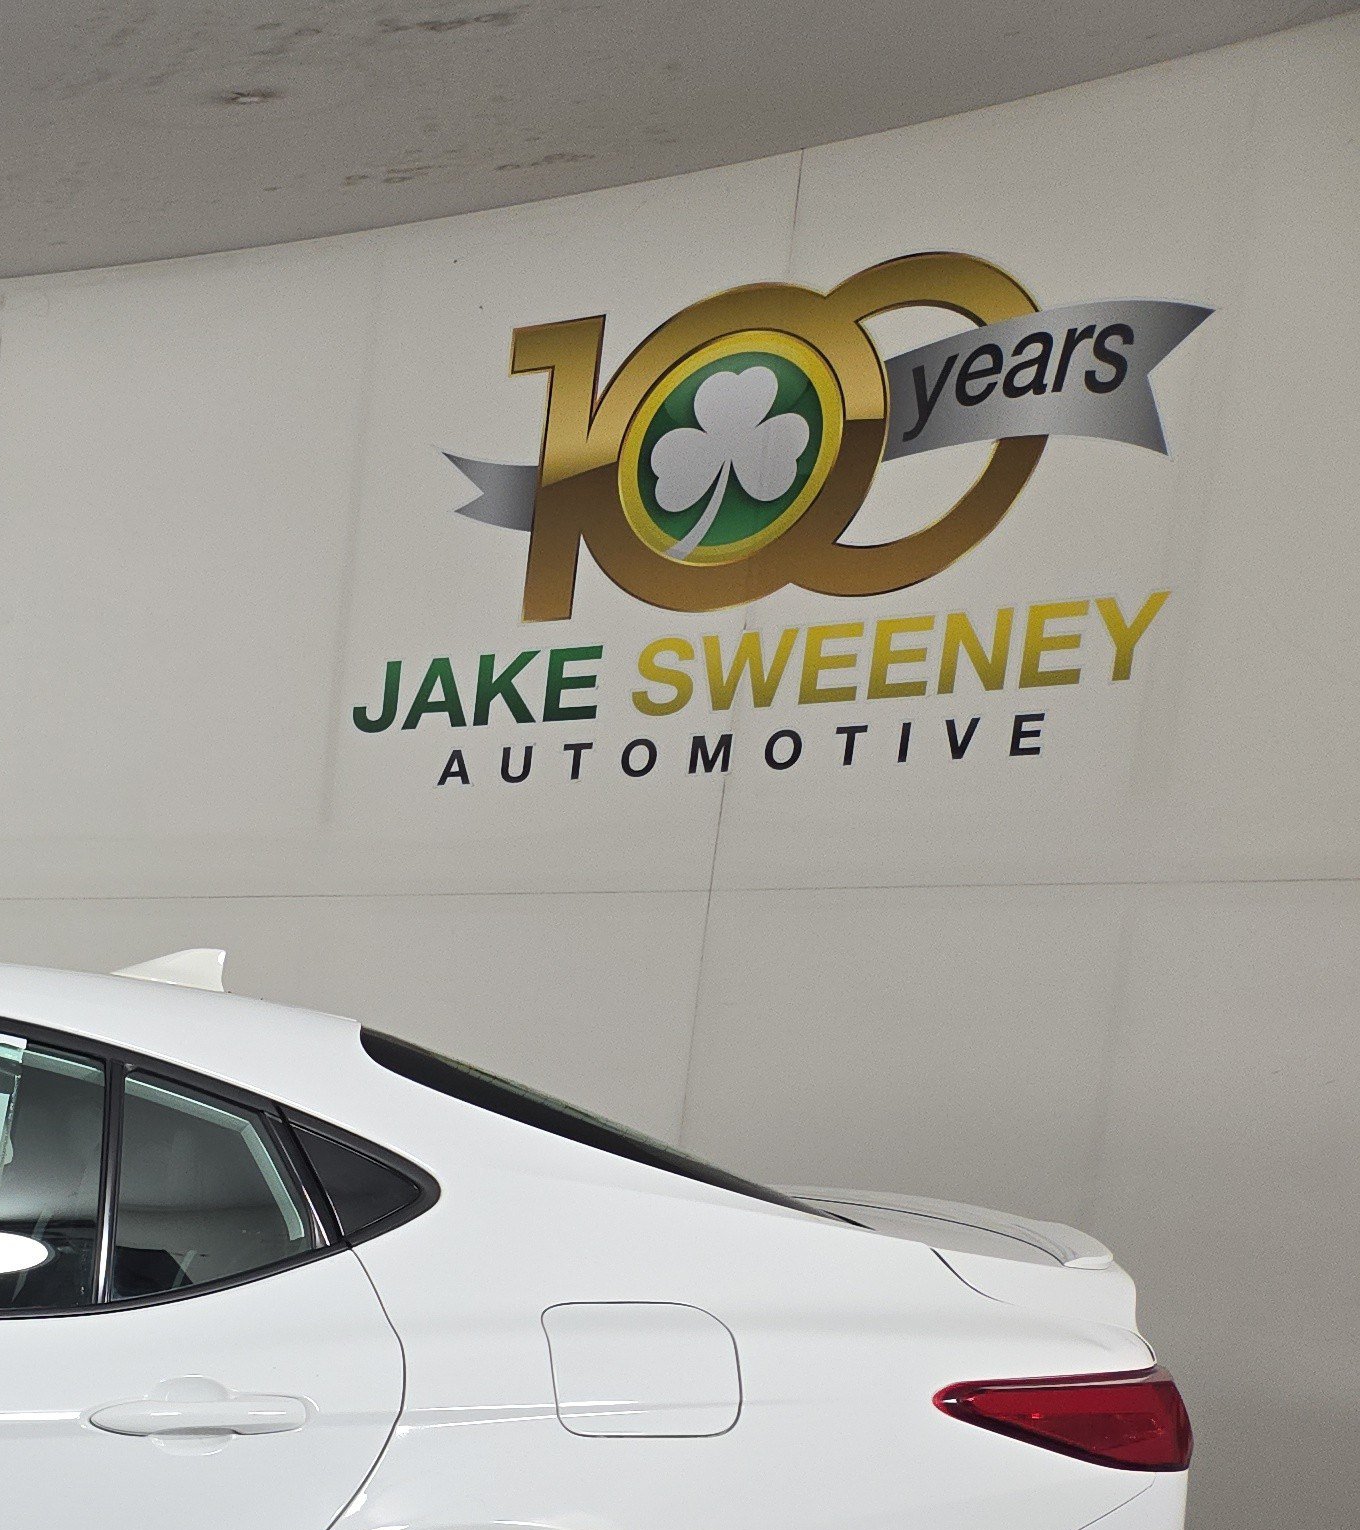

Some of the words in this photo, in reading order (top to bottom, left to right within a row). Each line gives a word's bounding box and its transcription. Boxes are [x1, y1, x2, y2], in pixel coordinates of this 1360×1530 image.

[511, 251, 1047, 623] 100
[902, 324, 1134, 442] years
[353, 645, 603, 733] JAKE
[632, 591, 1170, 716] SWEENEY
[438, 713, 1045, 785] AUTOMOTIVE
